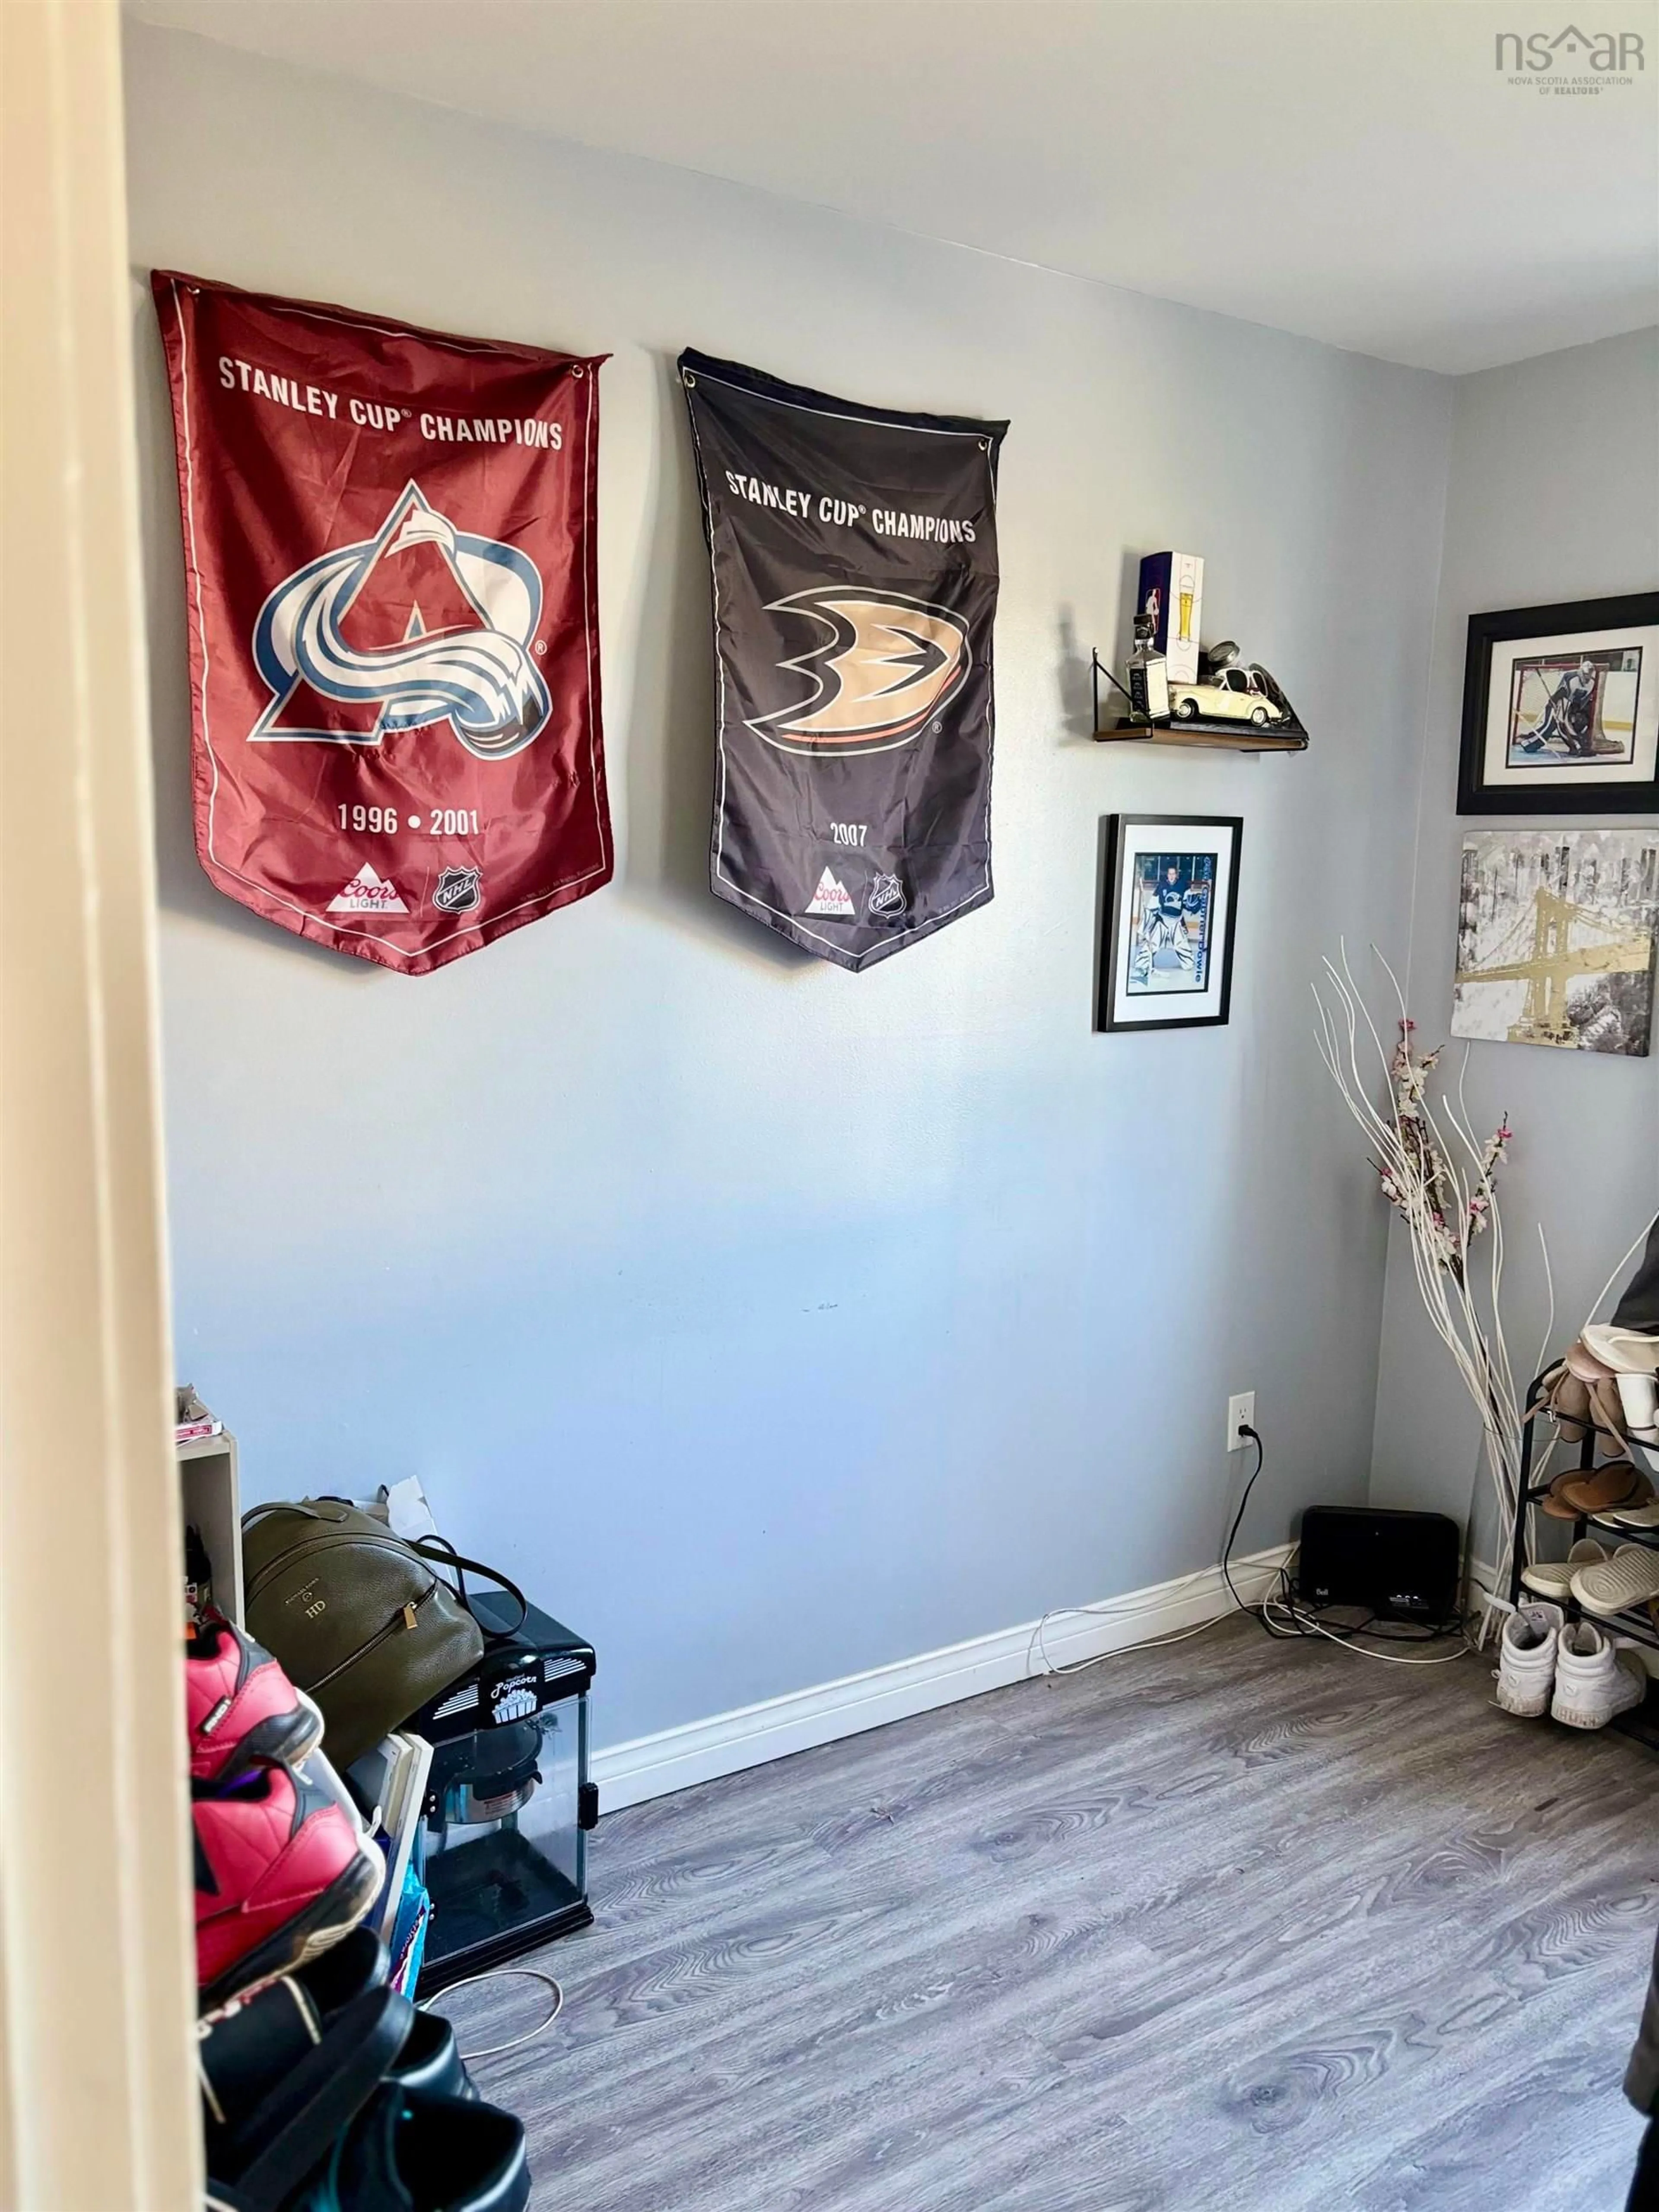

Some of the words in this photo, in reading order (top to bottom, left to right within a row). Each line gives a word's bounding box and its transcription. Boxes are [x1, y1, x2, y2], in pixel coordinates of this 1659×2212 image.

[219, 356, 337, 419] STANLEY
[421, 414, 562, 450] CHAMPIONS
[725, 470, 811, 518] STANLEY
[872, 509, 976, 543] CHAMPIONS
[338, 803, 398, 834] 1996
[430, 809, 479, 835] 2001
[830, 822, 867, 847] 2007
[340, 878, 400, 900] Coors
[443, 880, 472, 903] NHL
[814, 882, 851, 903] Coors
[350, 899, 388, 909] LIGHT
[820, 902, 843, 912] LIGHT
[1195, 941, 1205, 982] Dowie
[306, 1600, 326, 1619] HD
[491, 1675, 537, 1698] Popcorn
